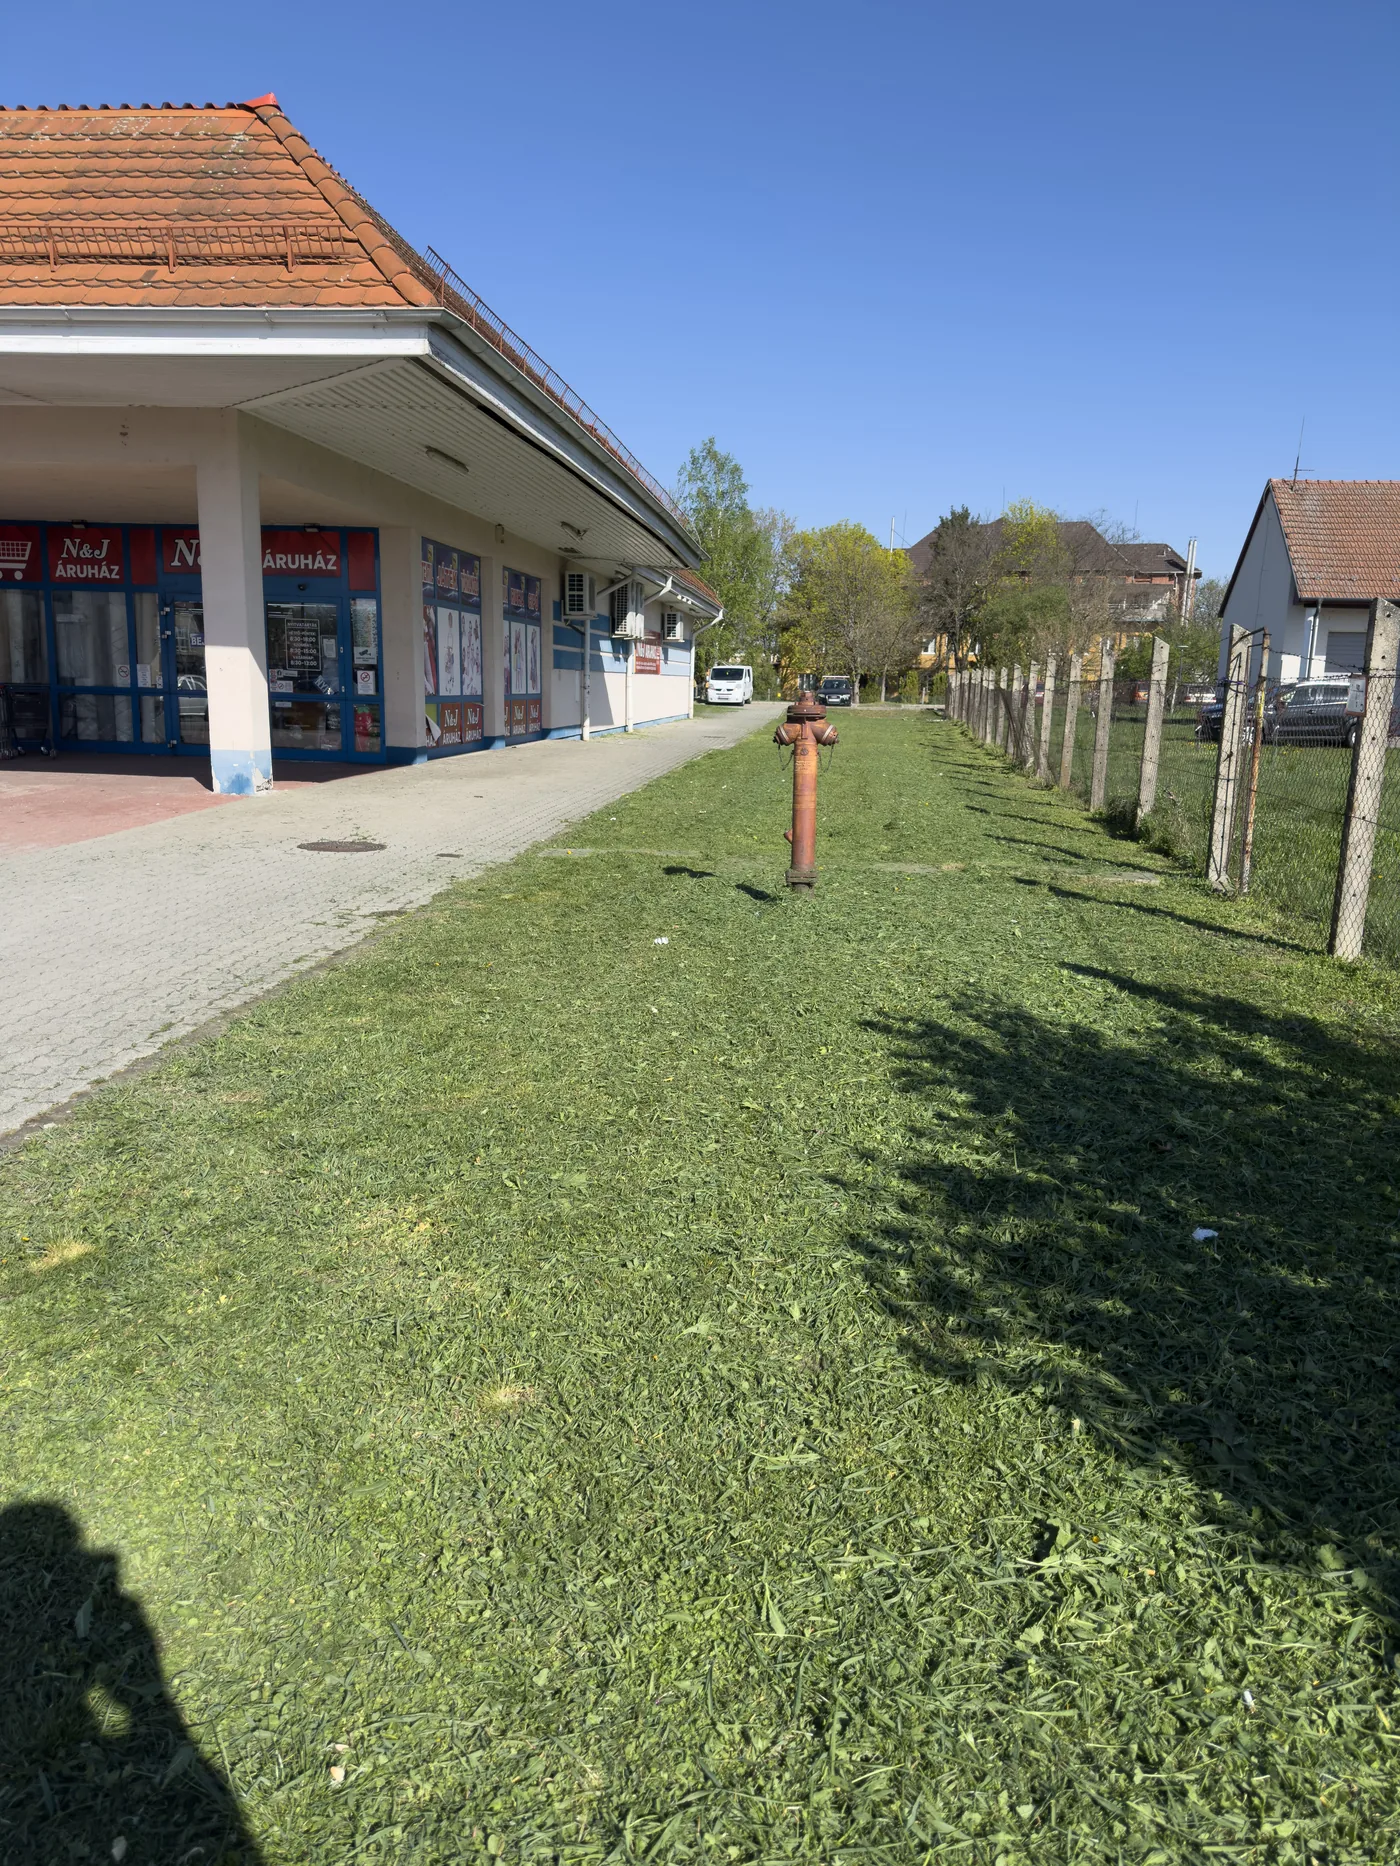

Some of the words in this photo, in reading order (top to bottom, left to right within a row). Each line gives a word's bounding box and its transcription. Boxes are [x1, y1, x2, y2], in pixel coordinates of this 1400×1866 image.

[60, 538, 111, 559] N&J
[262, 549, 337, 570] ÁRUHÁZ
[55, 560, 120, 579] ÁRUHÁZ
[444, 709, 458, 727] N&J
[467, 708, 480, 725] N&J
[443, 729, 461, 745] ÁRUHÁZ
[465, 727, 482, 742] ÁRUHÁZ
